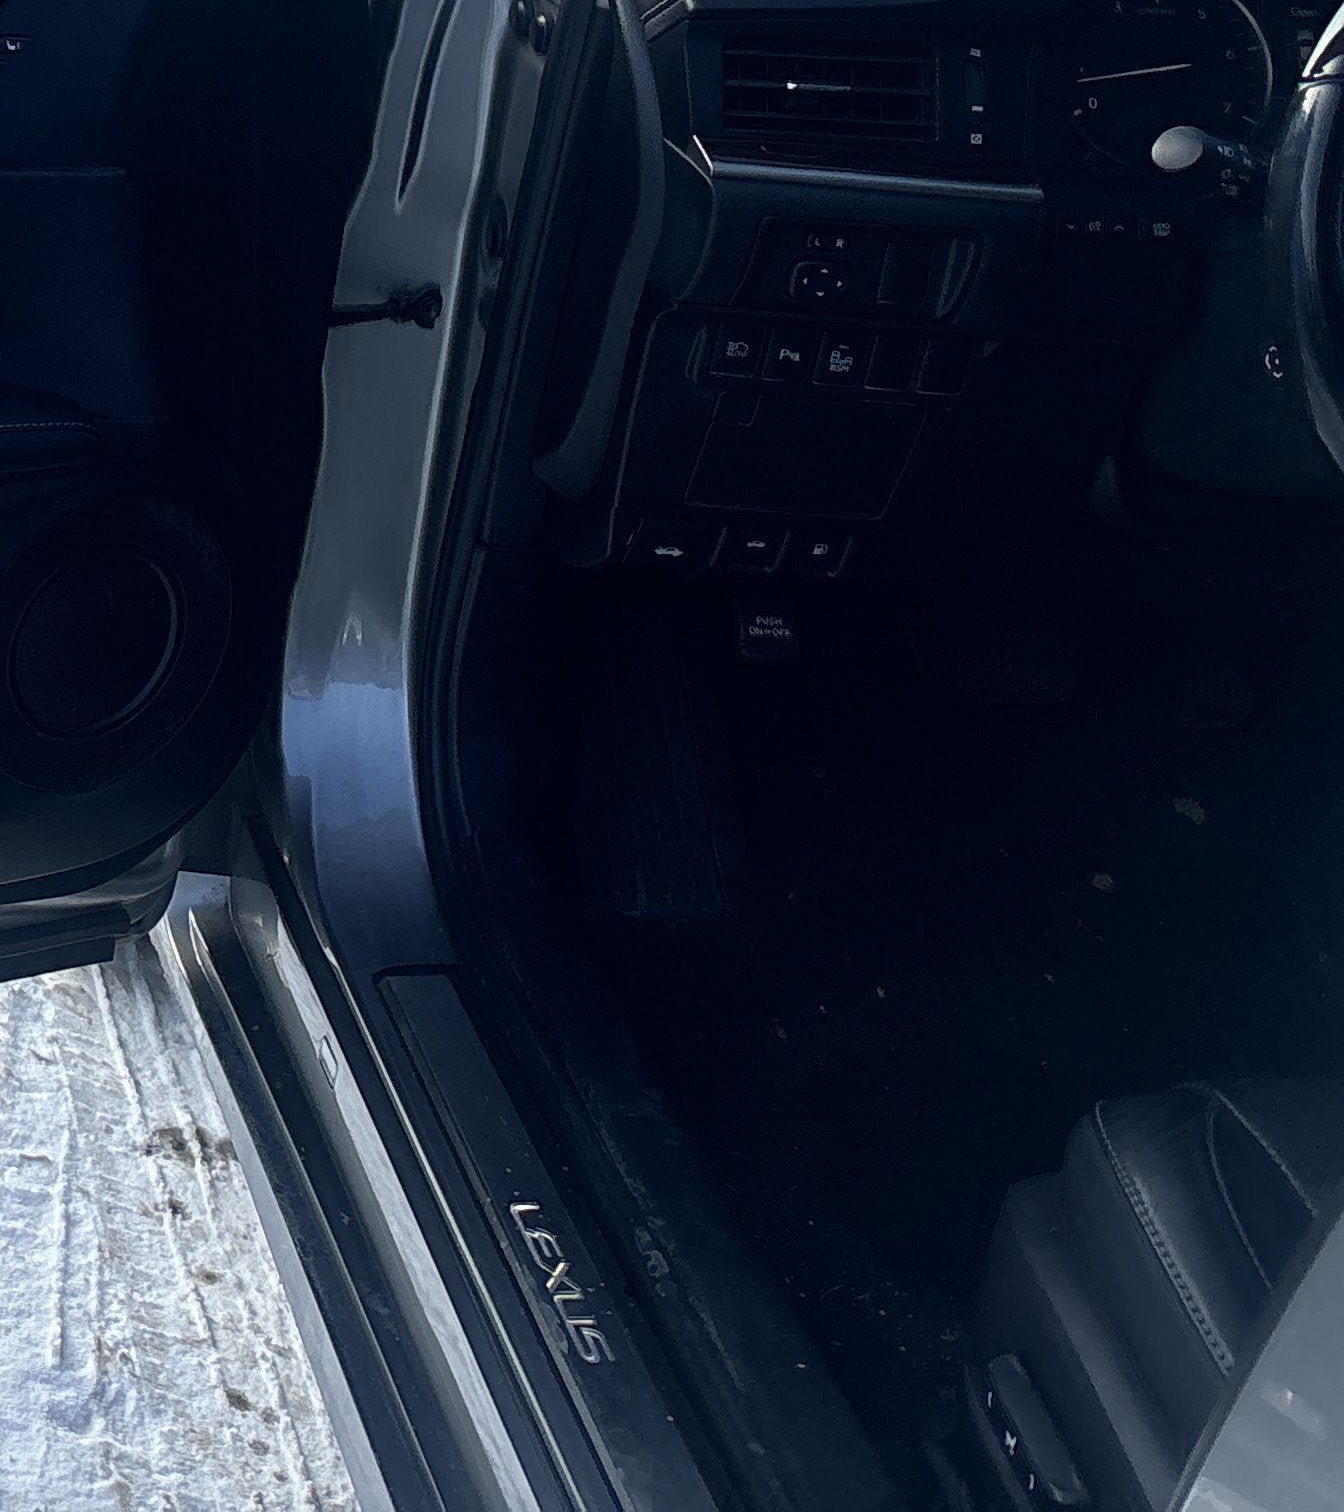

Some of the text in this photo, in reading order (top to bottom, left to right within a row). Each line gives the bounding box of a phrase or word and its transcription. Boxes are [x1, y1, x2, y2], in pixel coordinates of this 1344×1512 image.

[1088, 97, 1099, 110] 0
[755, 615, 783, 627] PUSH
[510, 1202, 616, 1364] LEXUS
